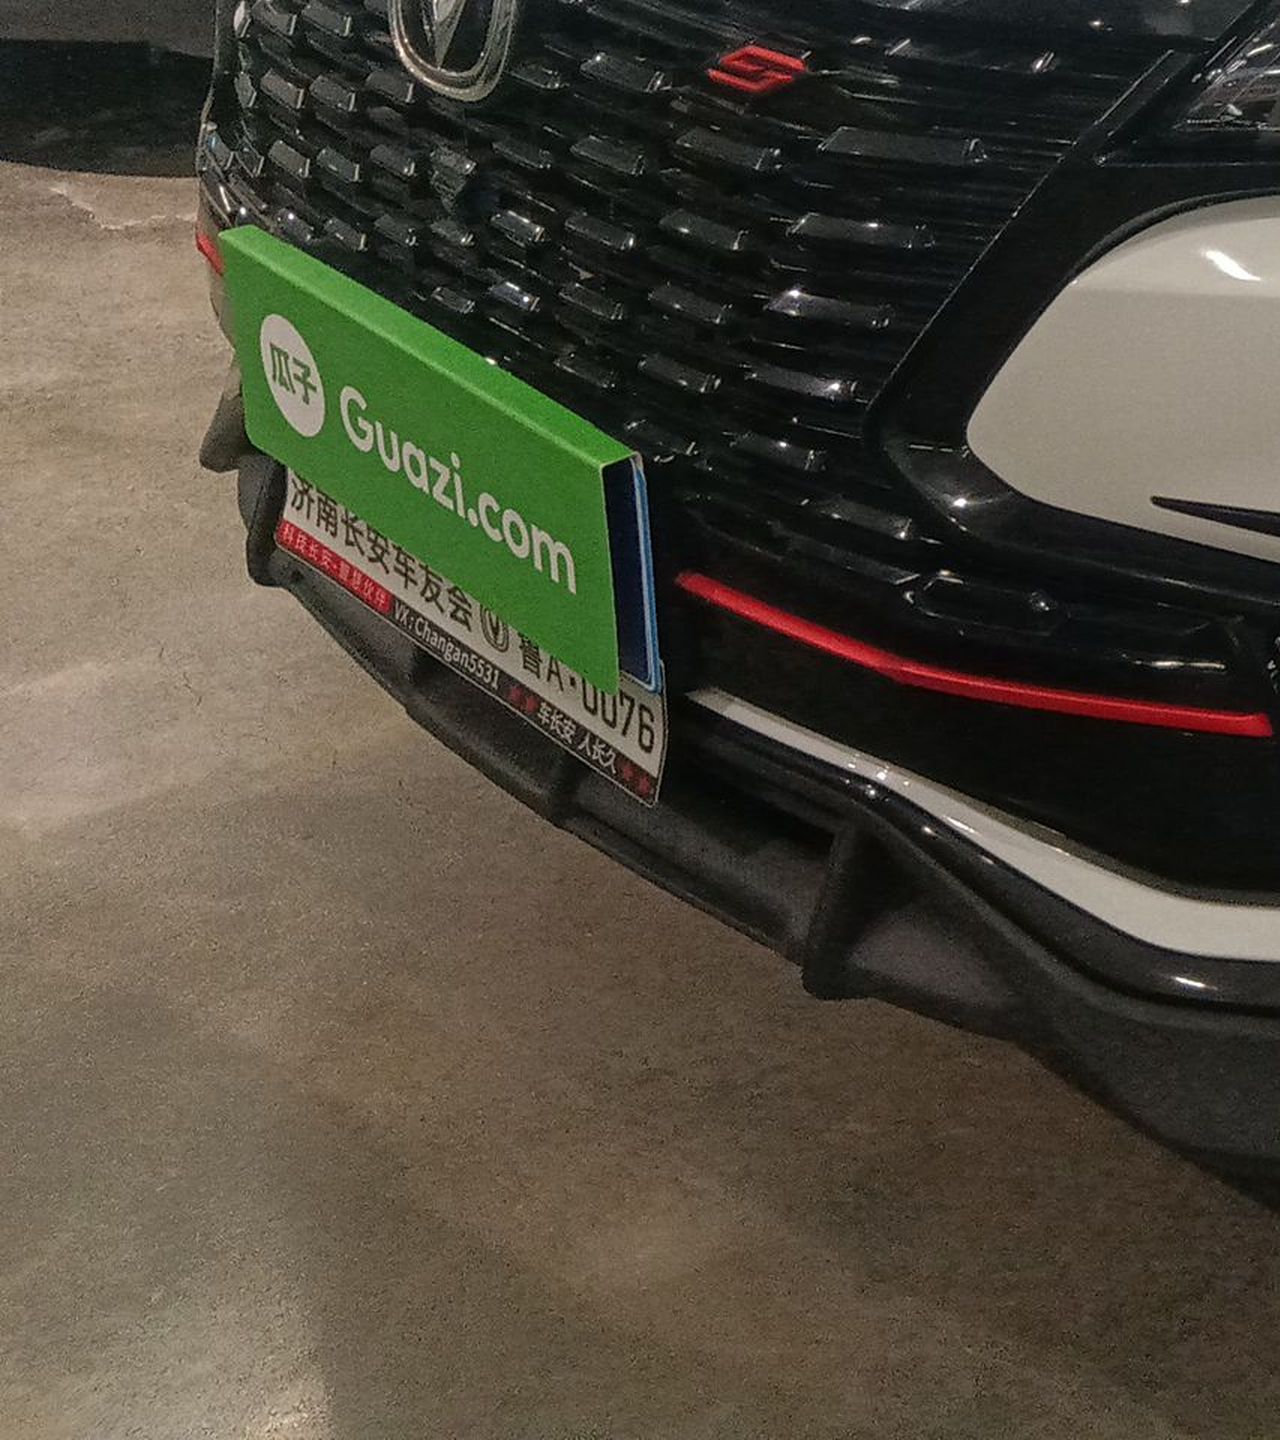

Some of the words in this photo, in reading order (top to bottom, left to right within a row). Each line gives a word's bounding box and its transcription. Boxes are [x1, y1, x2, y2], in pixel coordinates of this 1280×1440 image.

[269, 341, 318, 406] 瓜子
[339, 385, 577, 596] Guazi.com
[290, 476, 474, 633] 济南长安车友会
[536, 701, 577, 744] 车长安
